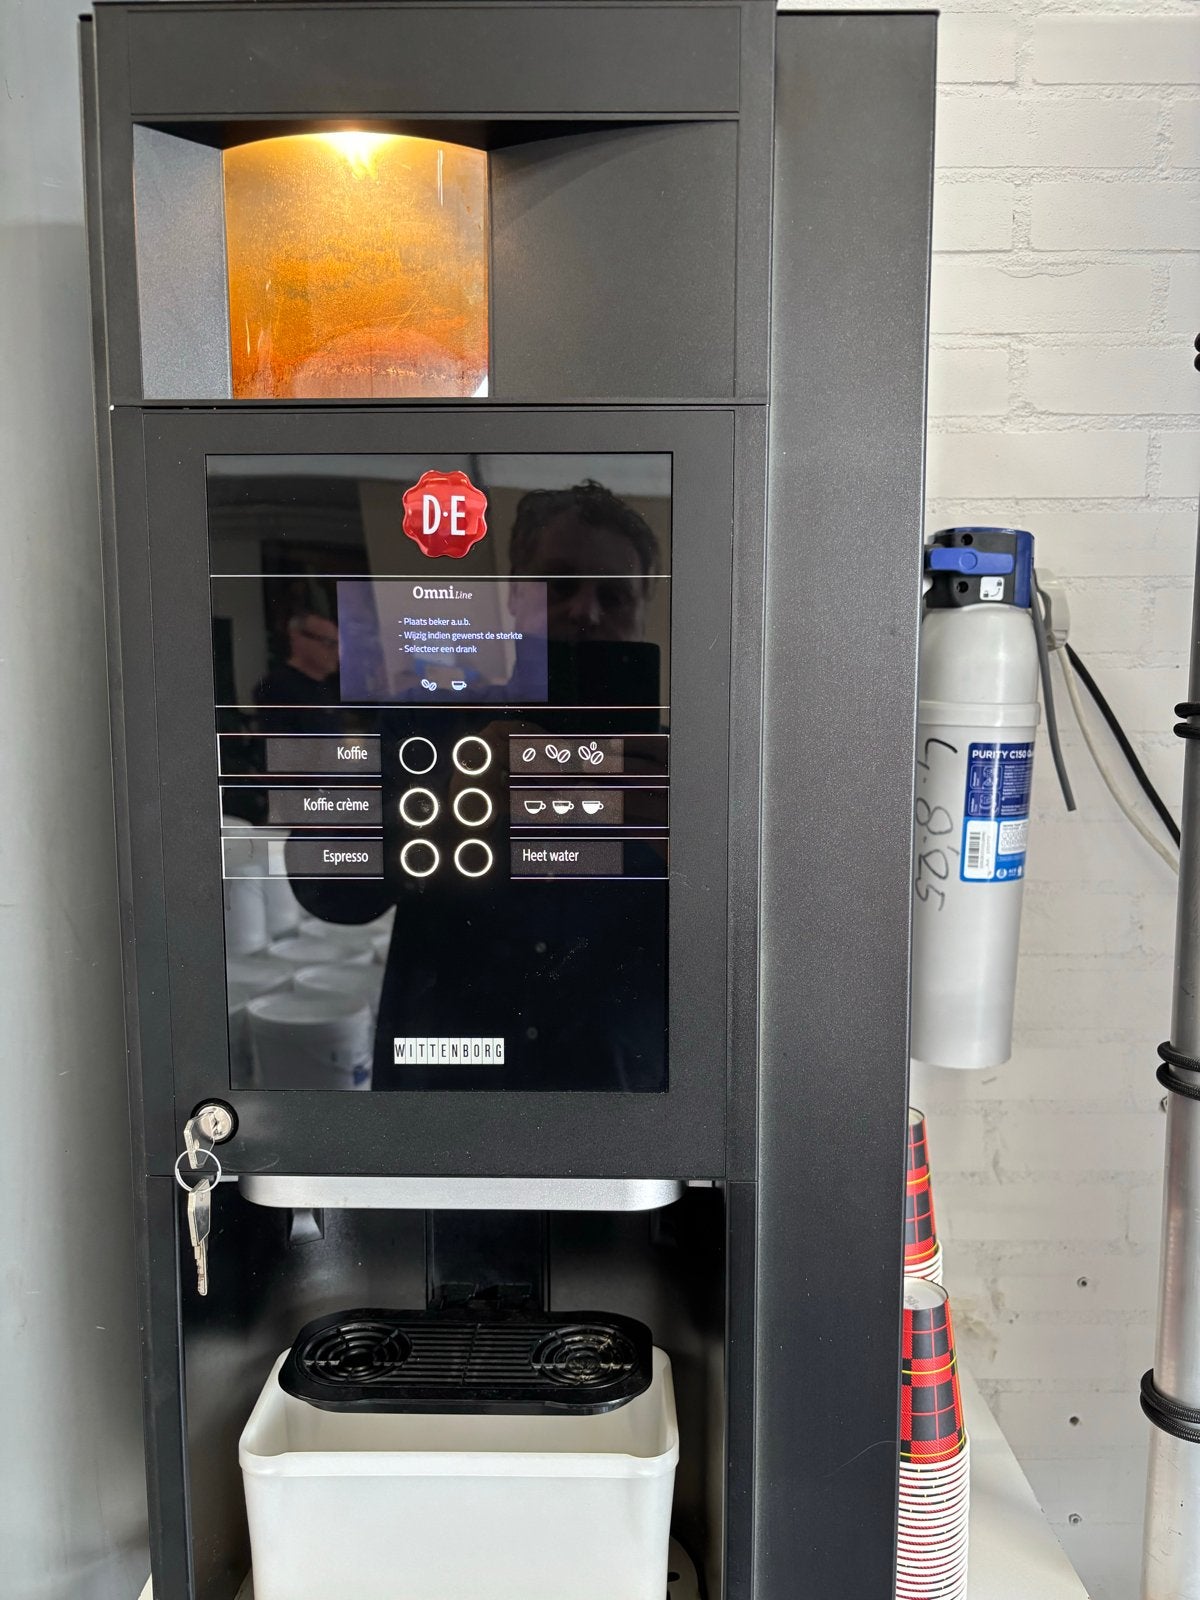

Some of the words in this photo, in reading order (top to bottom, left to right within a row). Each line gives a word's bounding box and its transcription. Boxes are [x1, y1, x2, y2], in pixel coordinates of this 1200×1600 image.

[403, 617, 428, 626] Plaats
[428, 617, 450, 626] beker
[450, 617, 471, 626] a.u.b.
[403, 631, 427, 641] Wijzig
[427, 631, 451, 640] indien
[451, 631, 483, 641] gewenst
[485, 631, 495, 640] de
[496, 631, 523, 640] sterkte
[404, 644, 439, 653] Selecteer
[455, 644, 478, 653] drank
[337, 746, 368, 760] Koffie
[972, 749, 1008, 760] PURITY
[1009, 749, 1027, 760] C150
[303, 797, 334, 811] Koffie
[336, 797, 369, 811] crème
[323, 849, 369, 866] Espresso
[522, 848, 548, 862] Heet
[549, 849, 580, 862] water
[394, 1042, 503, 1060] WITTENBORG
